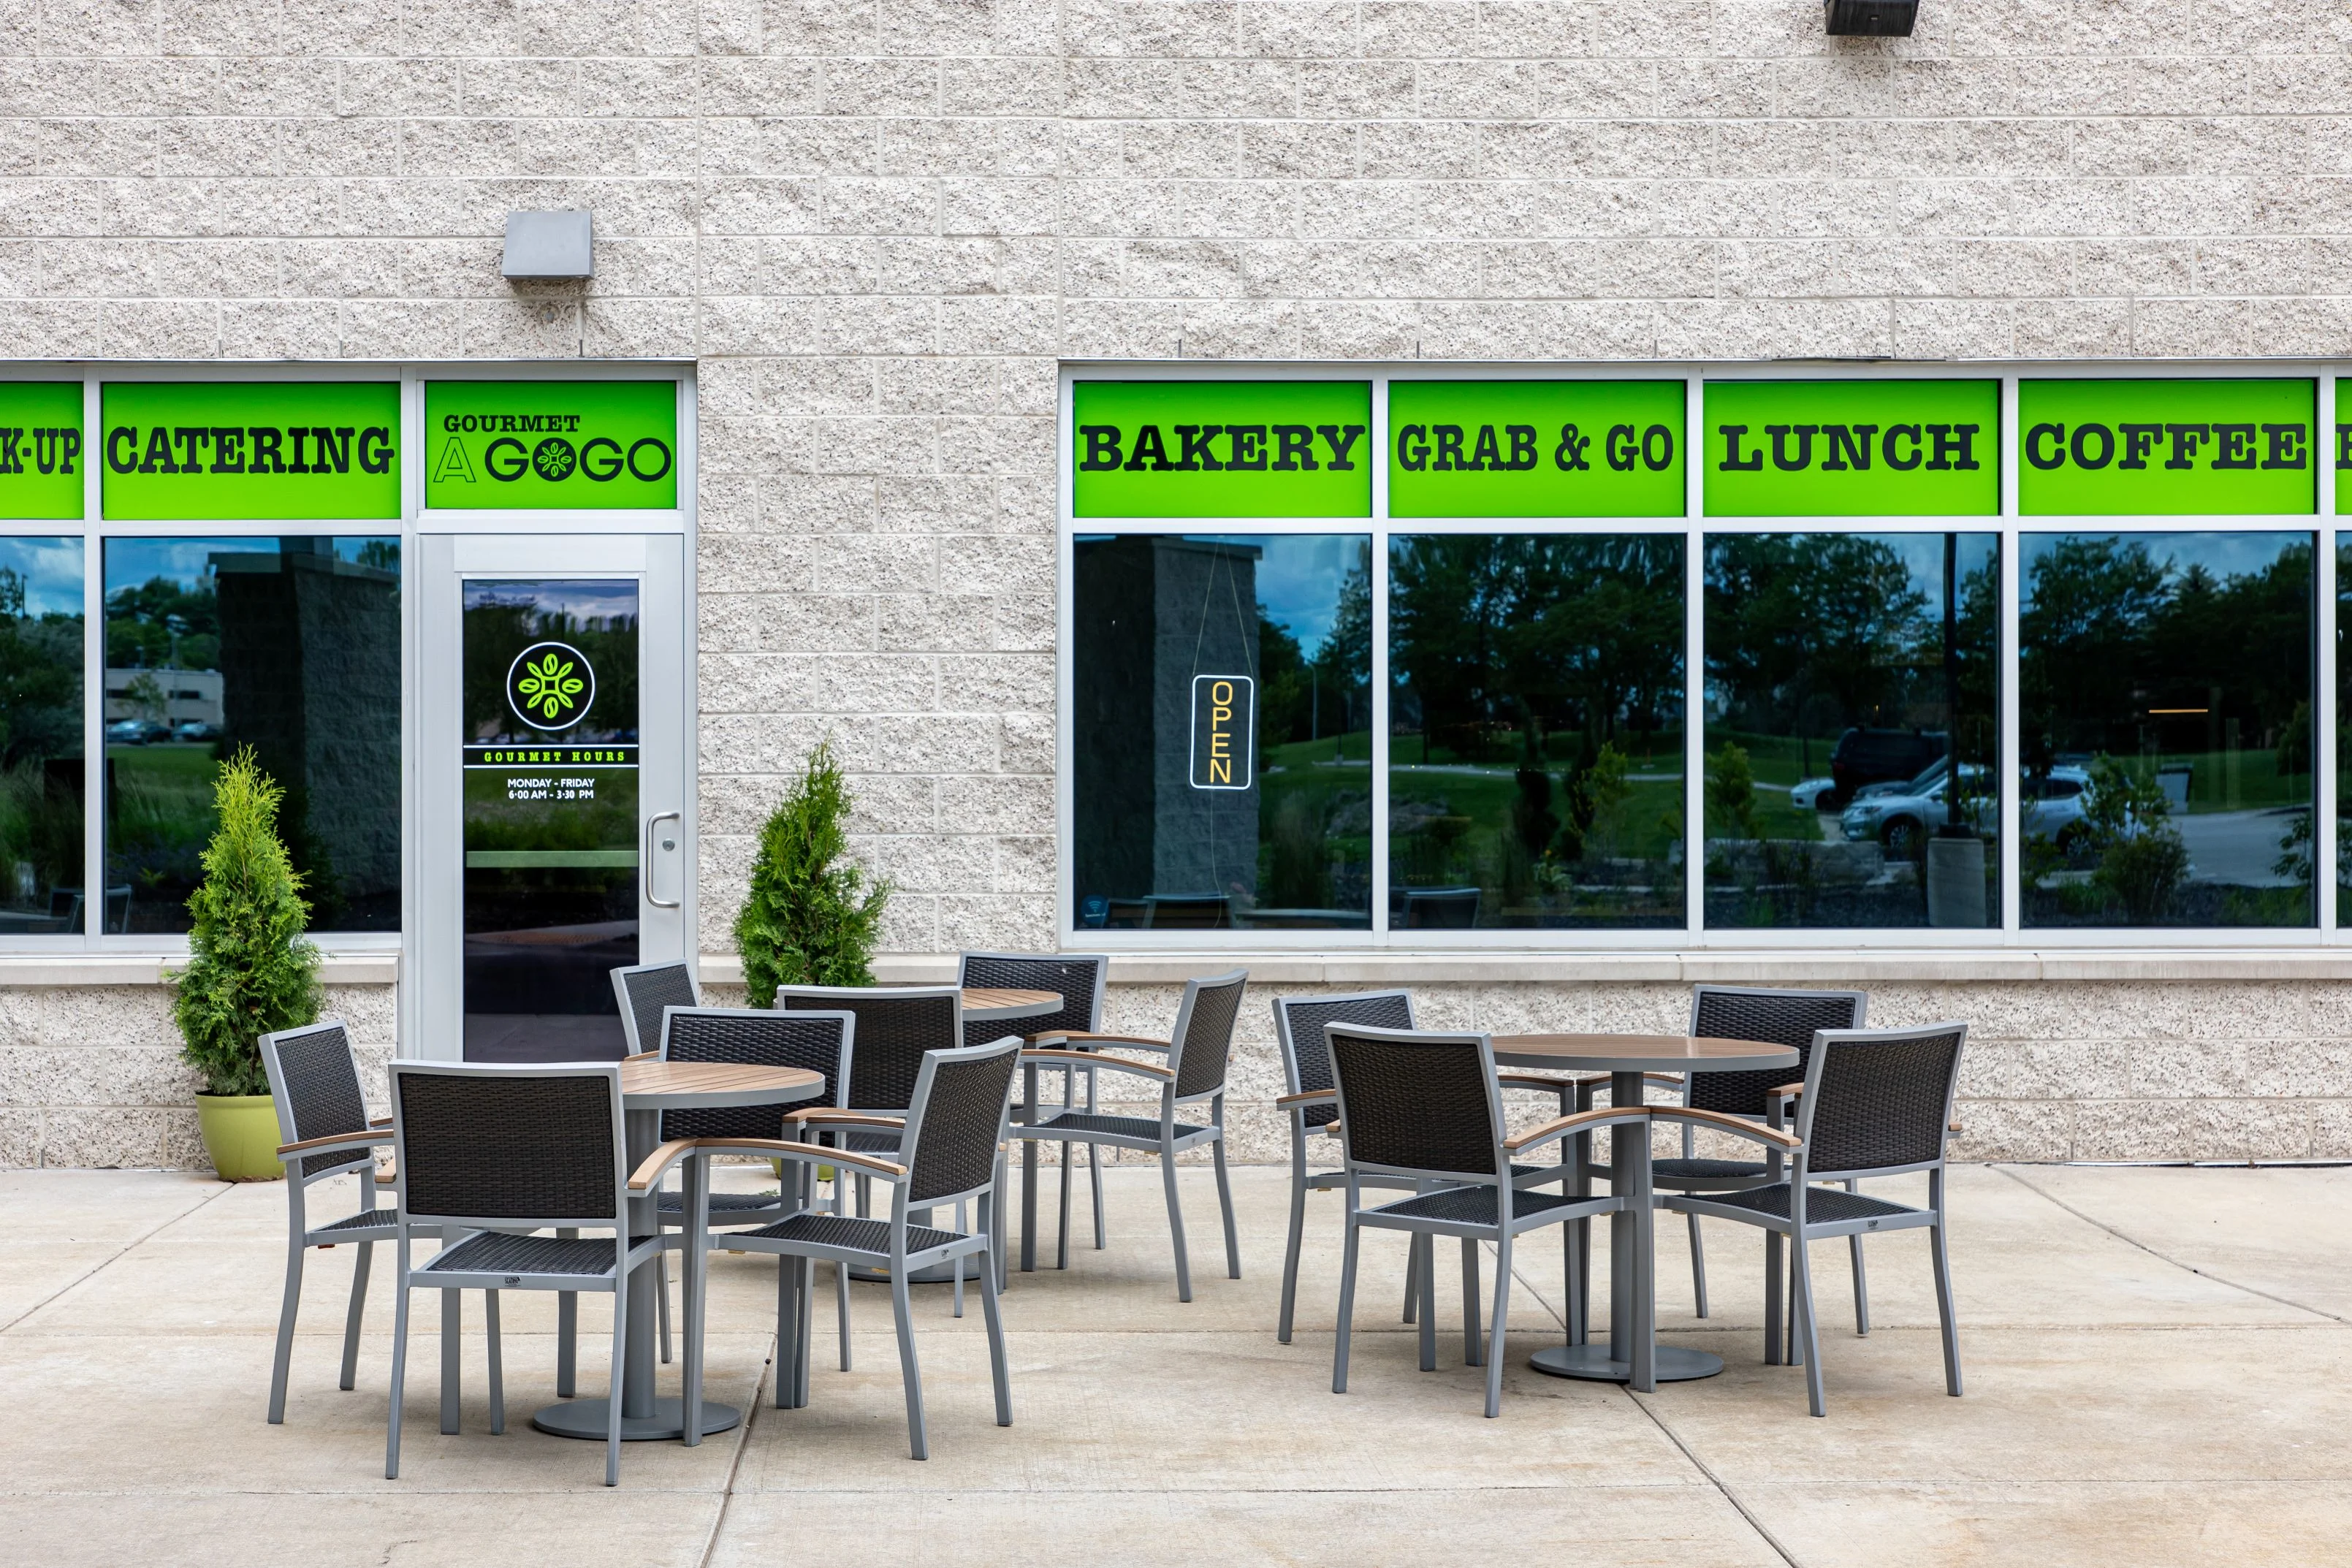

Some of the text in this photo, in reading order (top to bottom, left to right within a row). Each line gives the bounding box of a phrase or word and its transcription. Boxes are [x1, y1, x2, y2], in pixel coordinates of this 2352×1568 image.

[444, 414, 580, 433] GOURMET
[1398, 423, 1673, 471] GRAB & GO
[2025, 423, 2307, 470] COFFEE
[107, 426, 395, 474] CATERING
[433, 436, 477, 483] A
[1079, 425, 1366, 472] BAKERY
[1719, 424, 1980, 471] LUNCH
[1210, 681, 1233, 784] OPEN
[484, 751, 625, 762] GOURMET HOURS
[507, 778, 552, 788] MONDAY
[560, 777, 595, 788] FRIDAY
[530, 790, 547, 799] AM
[579, 789, 594, 799] PM
